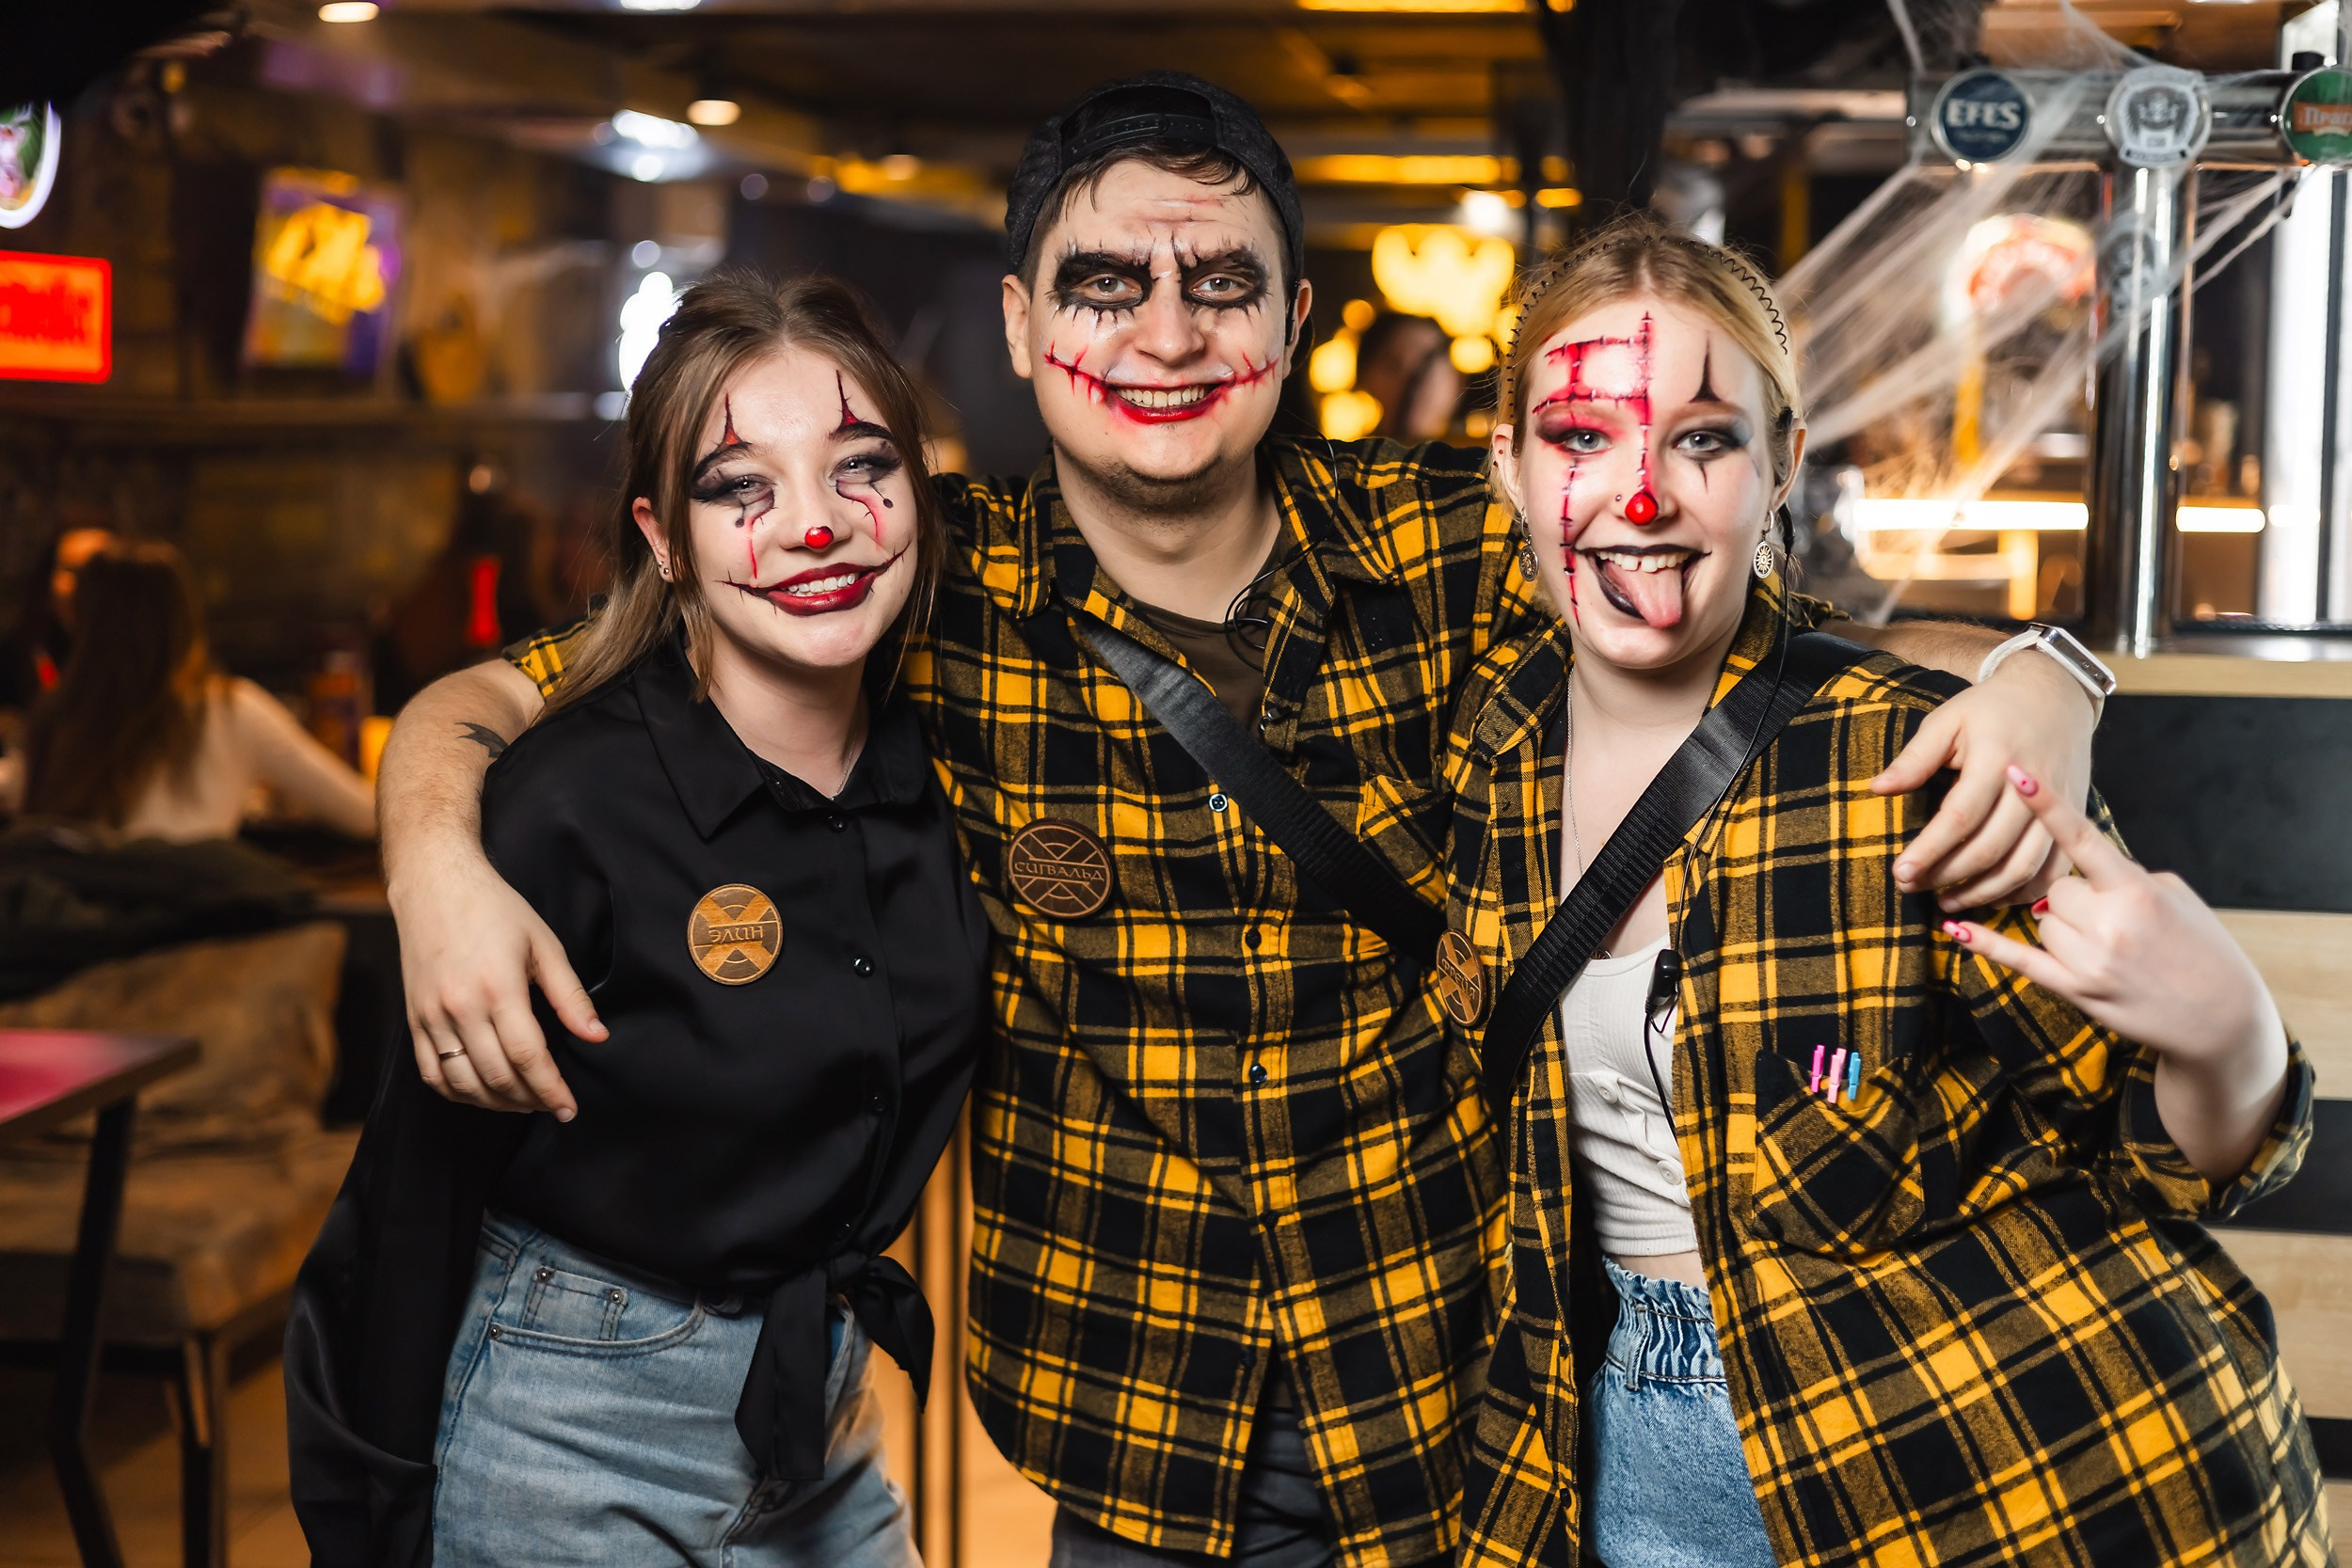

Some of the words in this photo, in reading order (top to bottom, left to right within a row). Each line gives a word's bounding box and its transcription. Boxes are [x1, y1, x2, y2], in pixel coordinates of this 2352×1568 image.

[1947, 99, 2021, 130] EFES
[1014, 862, 1104, 881] СИГВАЛЬД
[708, 926, 764, 944] ЭЛИН
